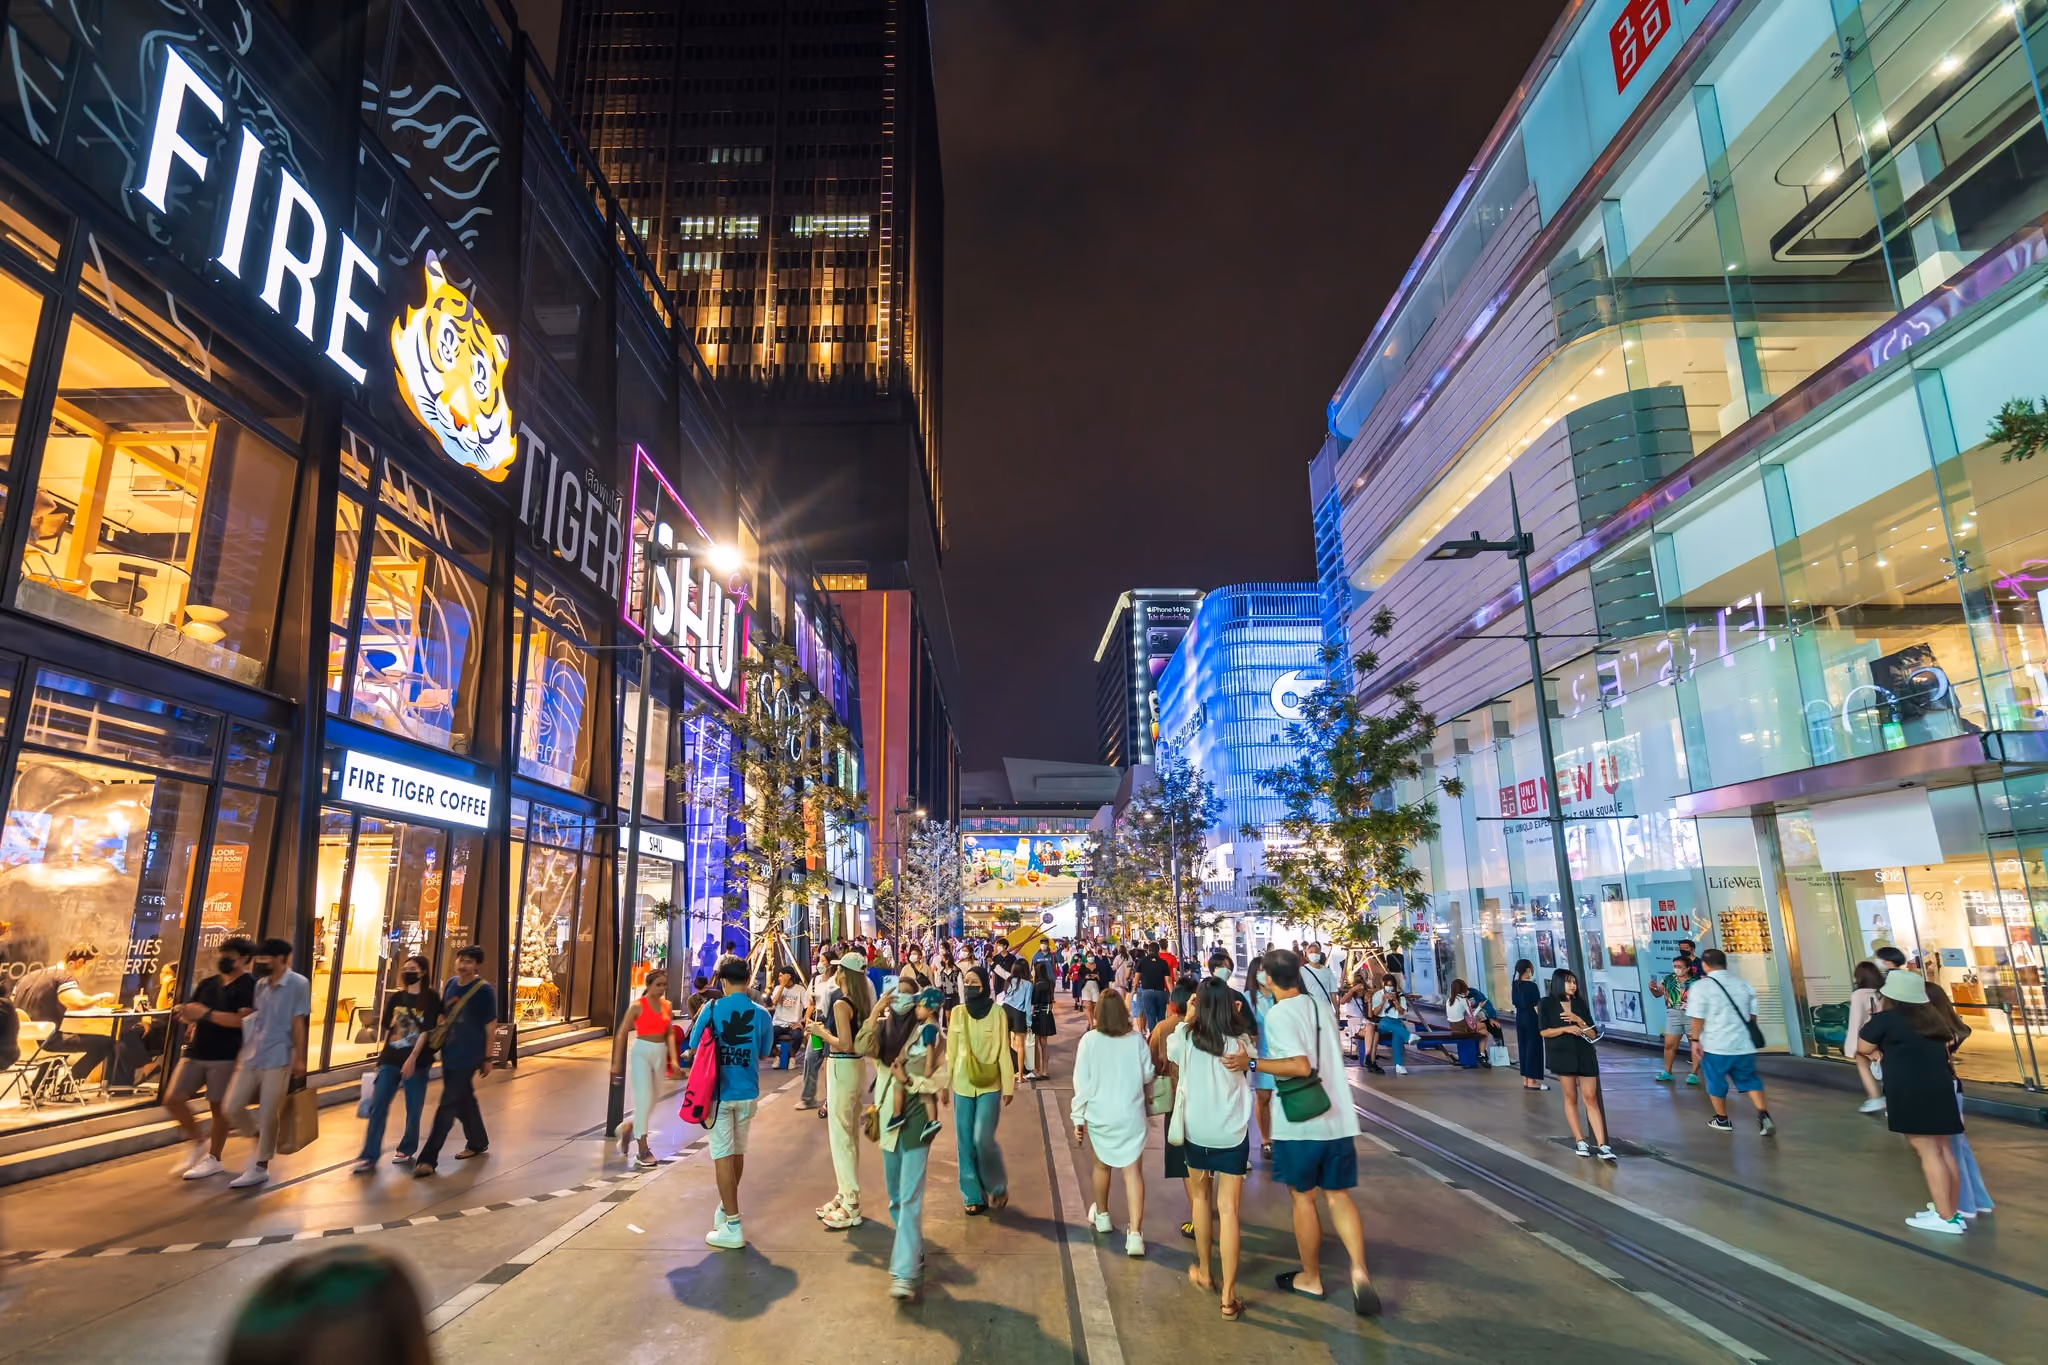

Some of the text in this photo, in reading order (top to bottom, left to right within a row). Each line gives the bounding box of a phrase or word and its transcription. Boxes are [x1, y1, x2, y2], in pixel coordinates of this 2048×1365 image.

[138, 44, 380, 385] FIRE
[518, 421, 623, 601] TIGER
[651, 522, 736, 691] SHU
[1601, 755, 1619, 795] U
[349, 767, 487, 817] FIRE TIGER COFFEE
[1520, 783, 1534, 798] UNI
[1521, 797, 1537, 812] QLO
[649, 837, 663, 853] SHU
[1708, 877, 1761, 889] LifeWea
[1651, 914, 1691, 932] NEW U
